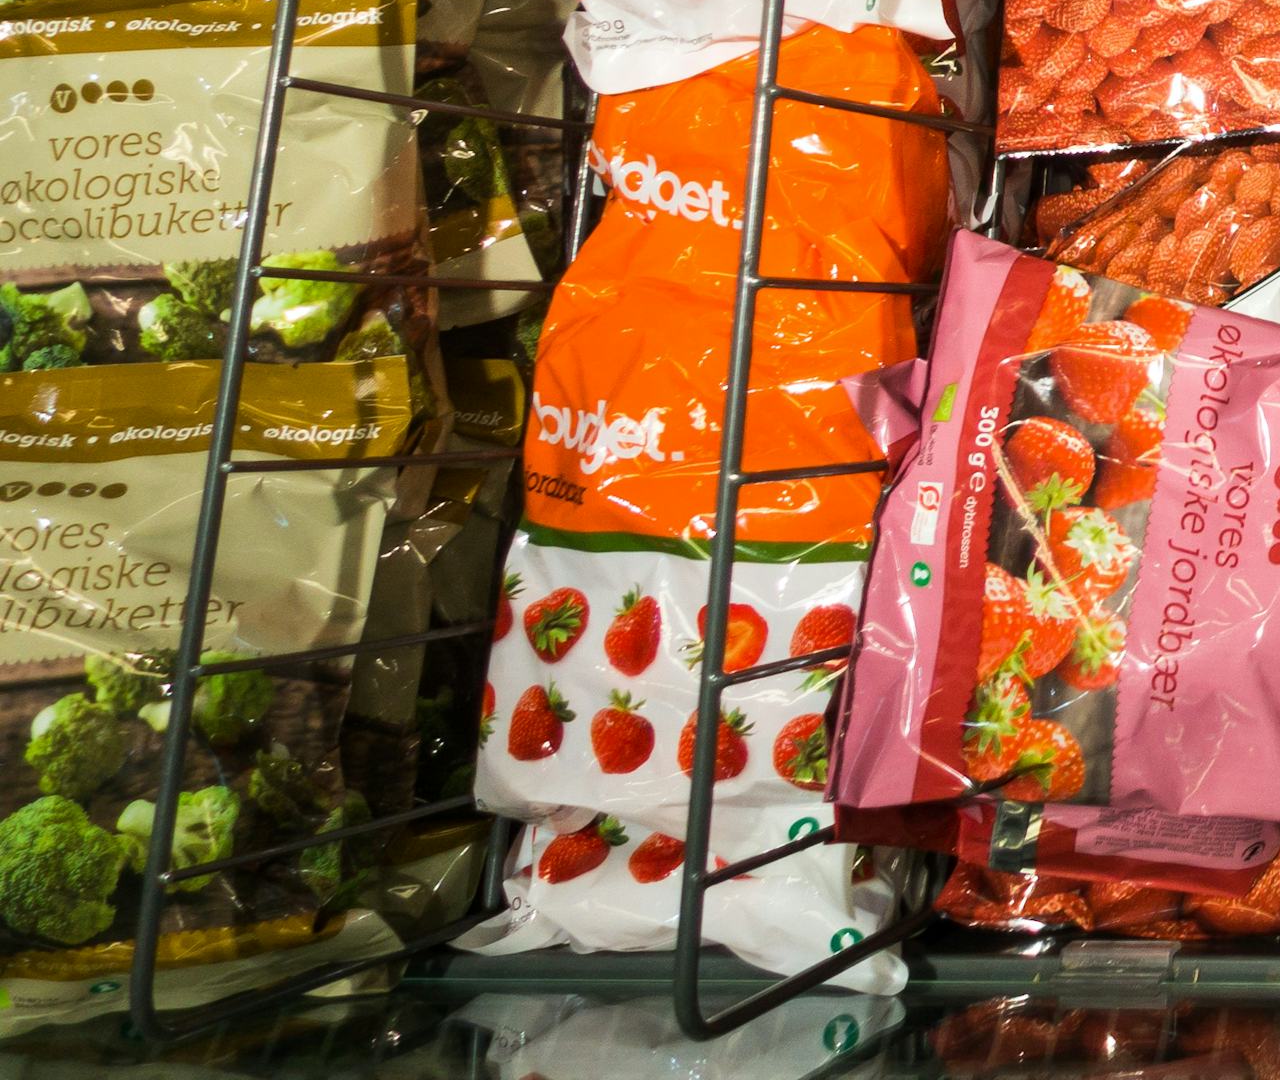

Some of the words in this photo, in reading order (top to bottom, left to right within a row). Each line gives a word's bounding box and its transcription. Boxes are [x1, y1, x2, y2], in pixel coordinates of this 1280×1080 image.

[125, 17, 242, 35] økologisk
[49, 130, 163, 162] vores
[1, 162, 221, 210] økologiske
[0, 198, 292, 244] occolibuketer
[109, 423, 213, 444] økologis
[262, 424, 381, 446] økologisk
[975, 406, 999, 447] 300
[1181, 323, 1243, 534] økologiske
[1215, 461, 1254, 570] vores
[0, 596, 244, 634] libuketer
[1150, 541, 1208, 712] jordbær
